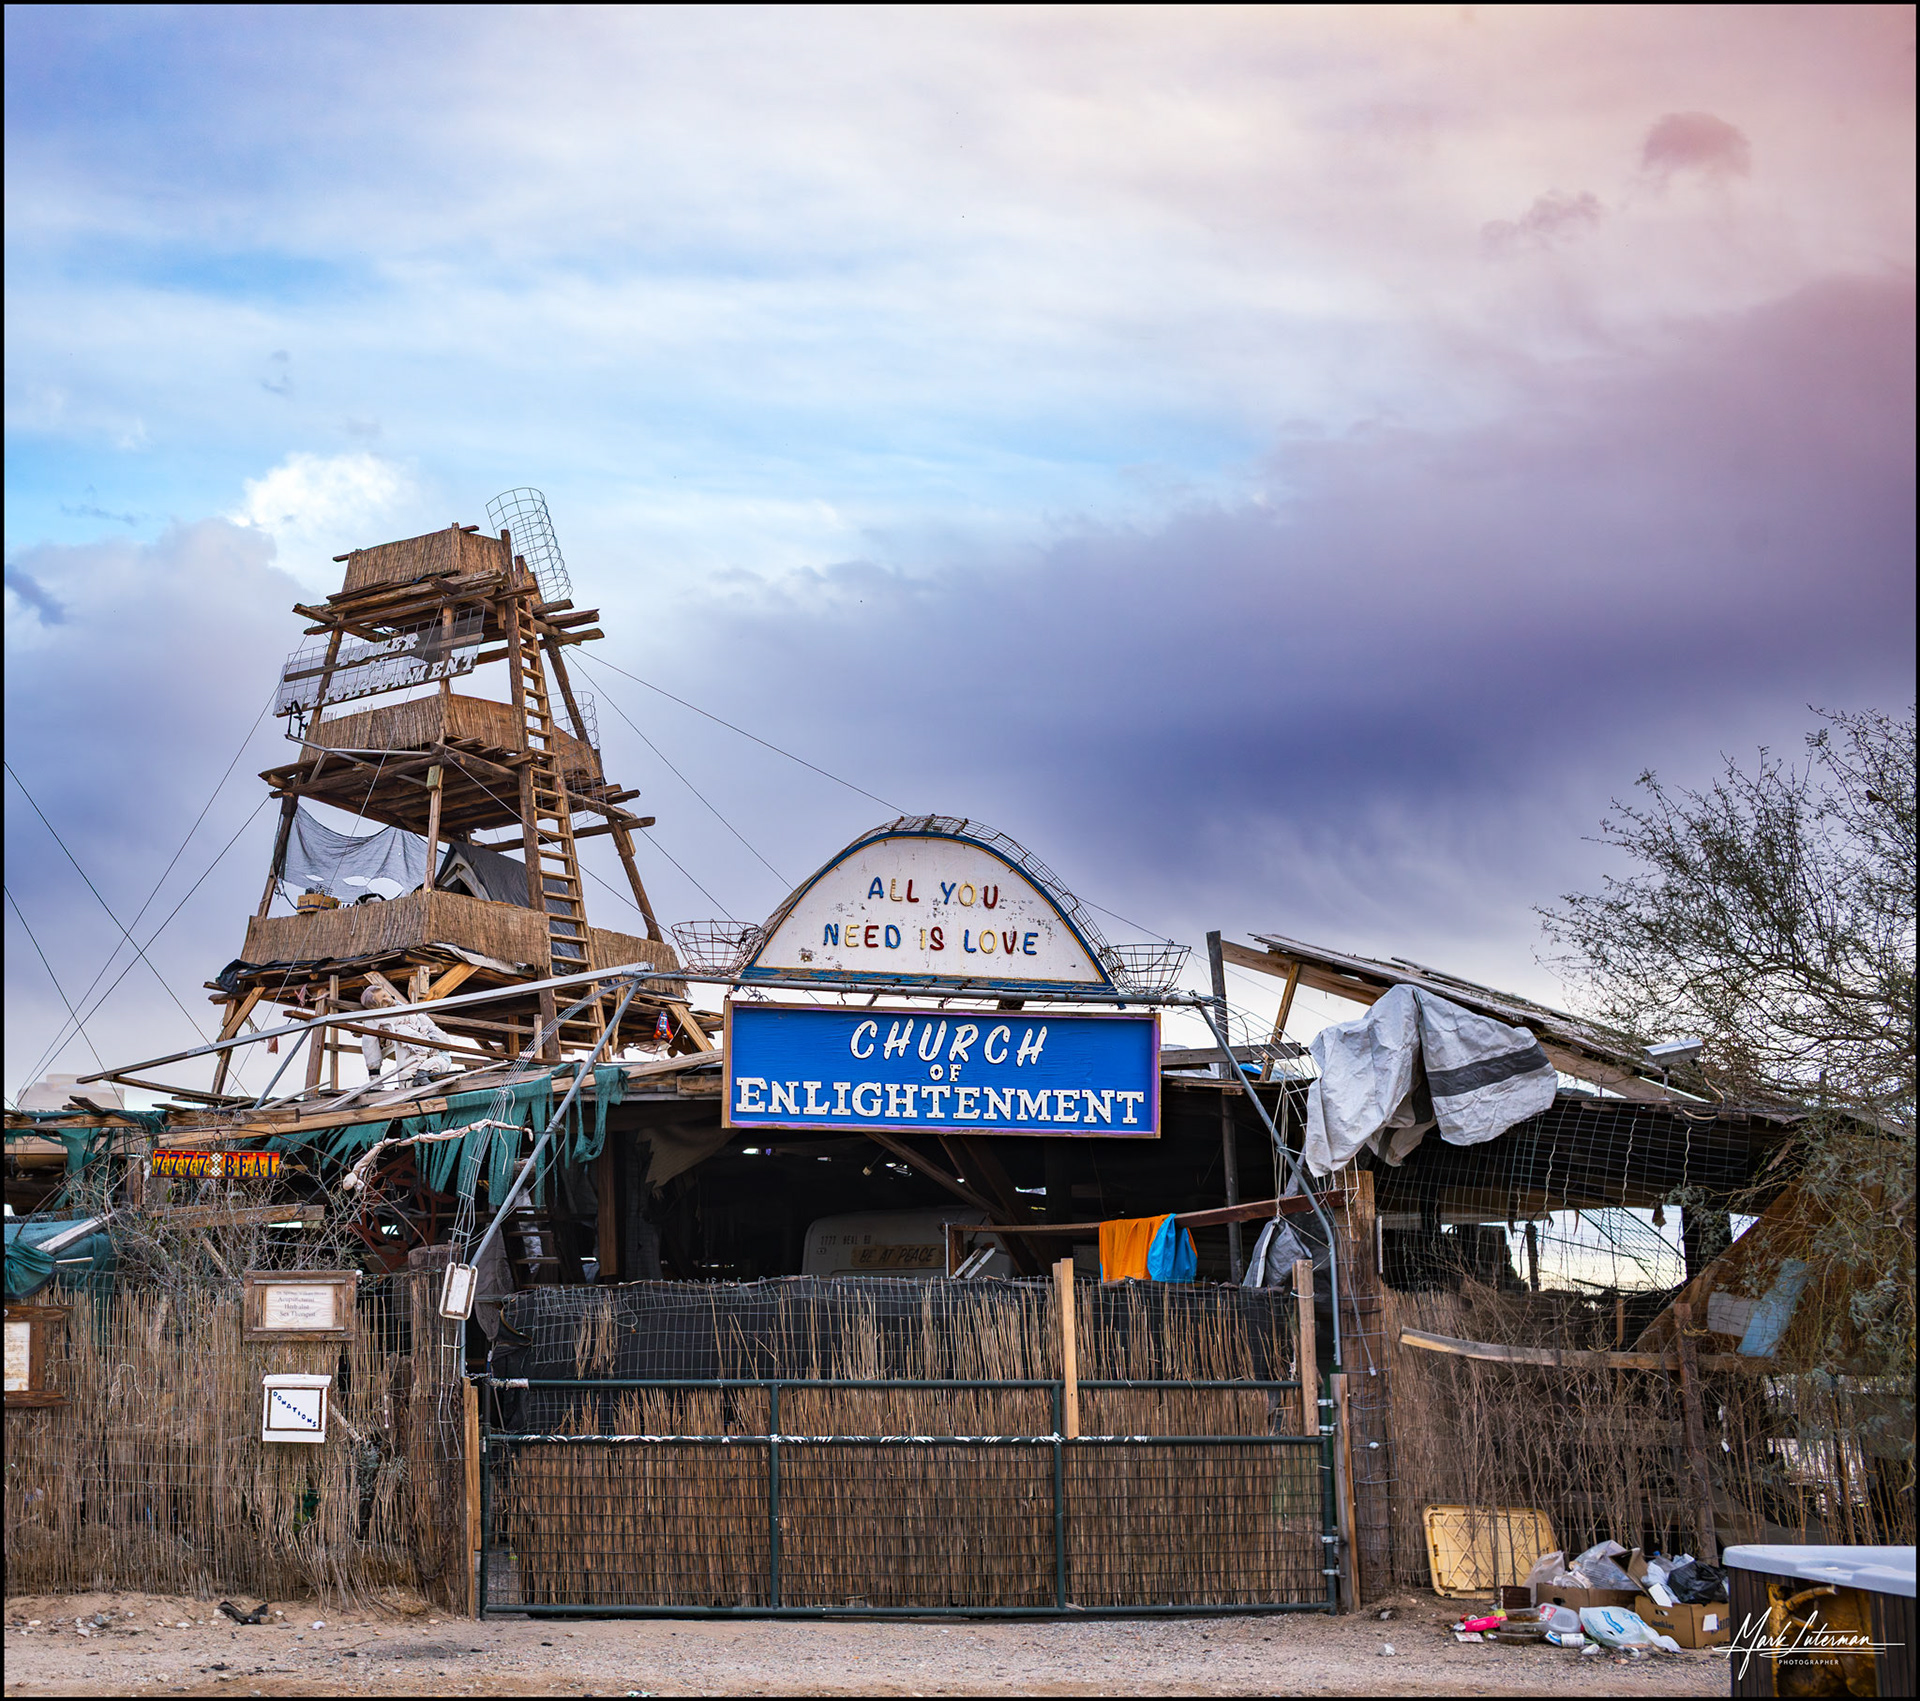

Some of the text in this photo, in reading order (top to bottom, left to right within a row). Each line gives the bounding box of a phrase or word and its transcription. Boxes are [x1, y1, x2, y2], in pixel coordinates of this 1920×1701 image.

[335, 632, 420, 668] TOWER
[867, 876, 999, 909] ALL YOU
[822, 922, 1040, 956] NEED IS LOVE
[849, 1018, 1048, 1067] CHURCH
[929, 1063, 963, 1082] OF
[735, 1076, 1145, 1124] ENLIGHTENMENT
[154, 1153, 278, 1178] 7777 BEAL
[859, 1247, 937, 1263] BE AT PEACE
[273, 1391, 316, 1427] DONATIONS
